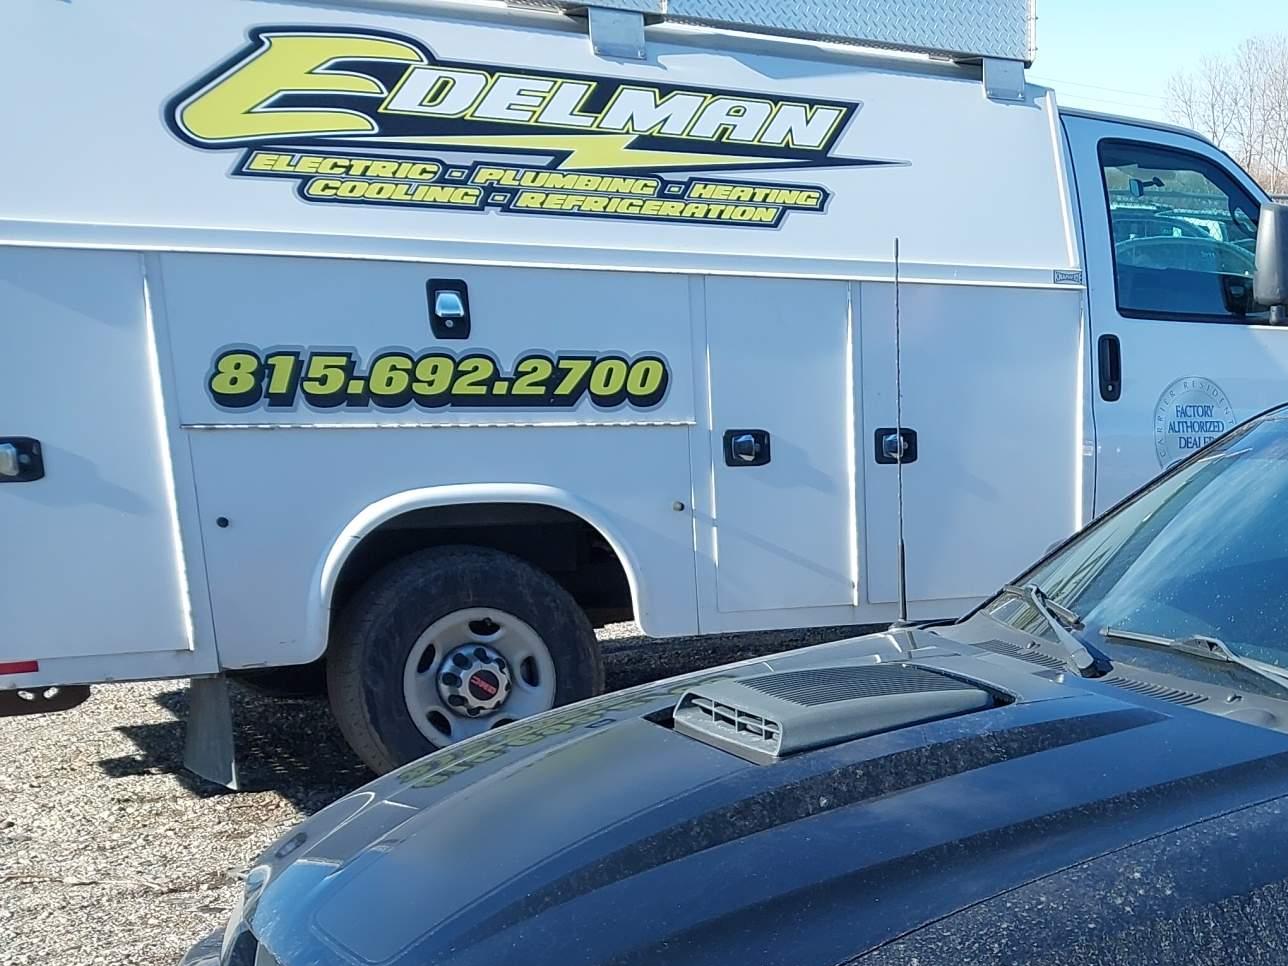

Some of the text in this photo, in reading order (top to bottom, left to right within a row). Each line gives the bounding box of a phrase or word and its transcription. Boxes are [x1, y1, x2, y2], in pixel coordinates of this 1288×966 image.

[178, 33, 851, 149] EDELMAN
[249, 153, 822, 206] ELECTRIC PLUMBING HEATING
[307, 178, 779, 222] COOLING REFRIGERATION
[210, 353, 666, 398] 815.692.2700
[1168, 421, 1225, 434] AUTHORIZED
[1175, 405, 1214, 418] FACTORY
